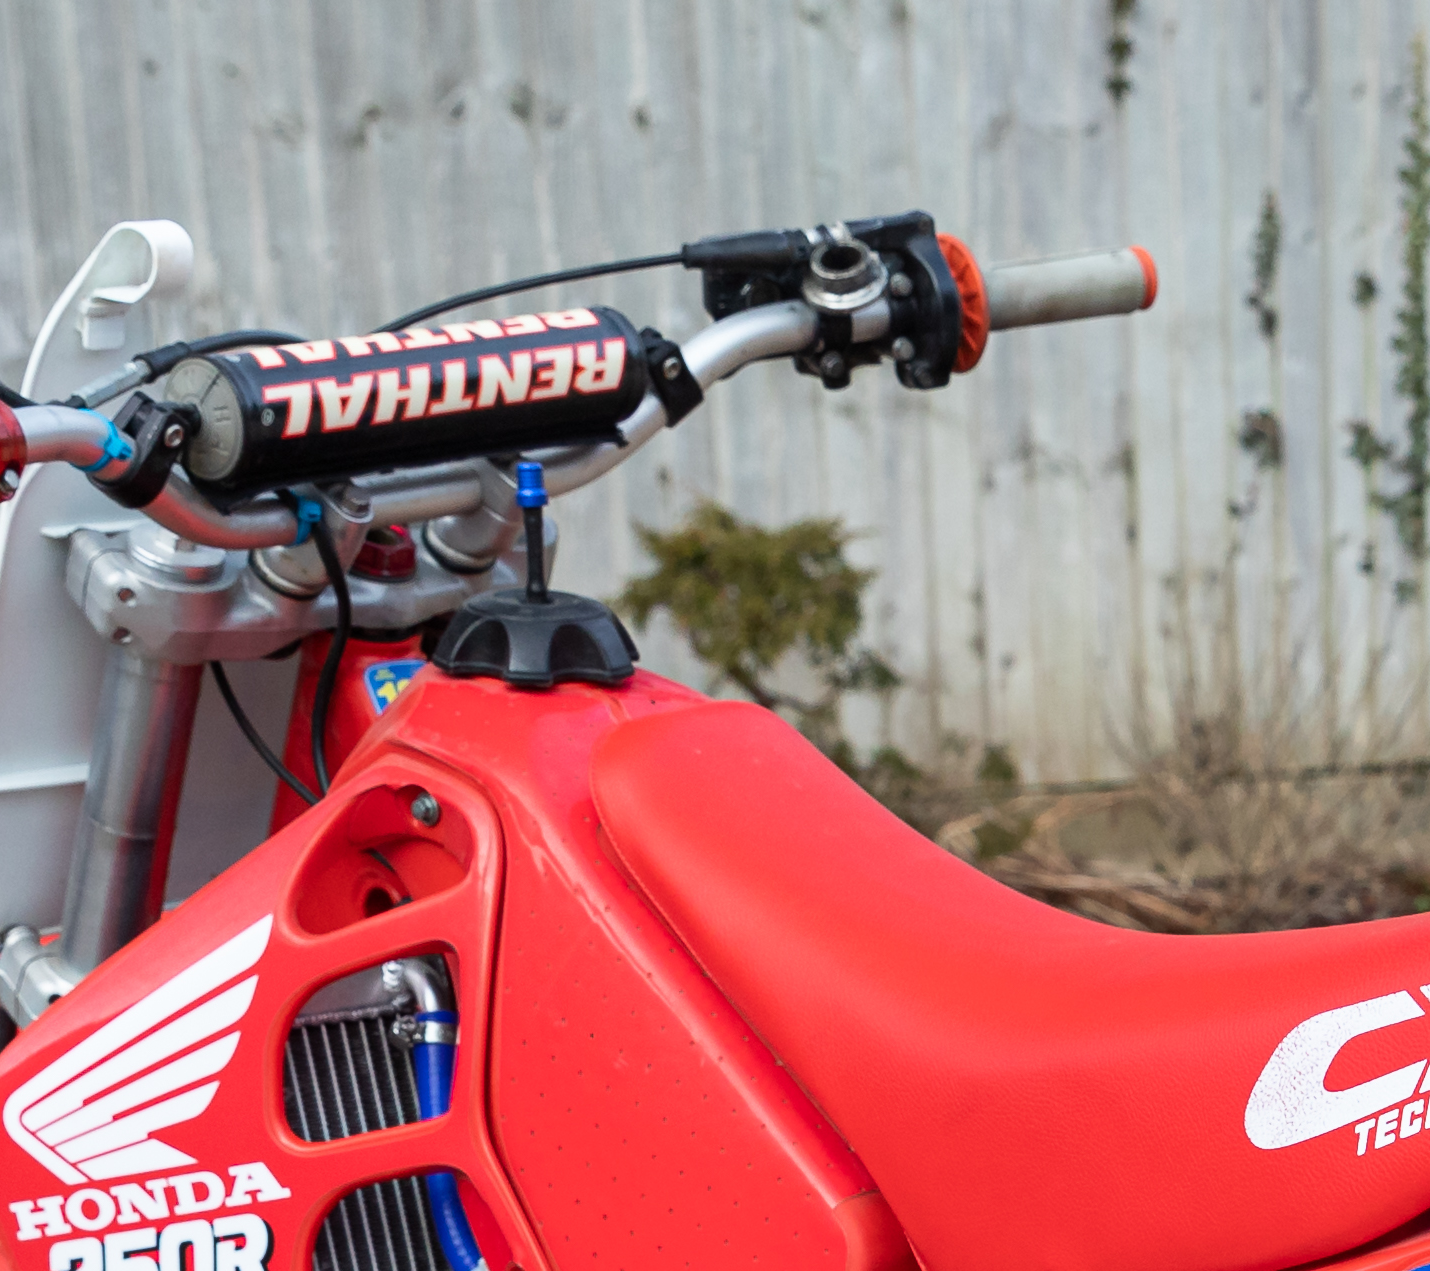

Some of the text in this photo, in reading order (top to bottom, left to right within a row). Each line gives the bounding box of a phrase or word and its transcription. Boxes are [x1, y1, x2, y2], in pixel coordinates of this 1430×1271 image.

[246, 306, 600, 370] RENTHAL
[262, 336, 627, 441] RENTHAL
[10, 1161, 291, 1242] HONDA
